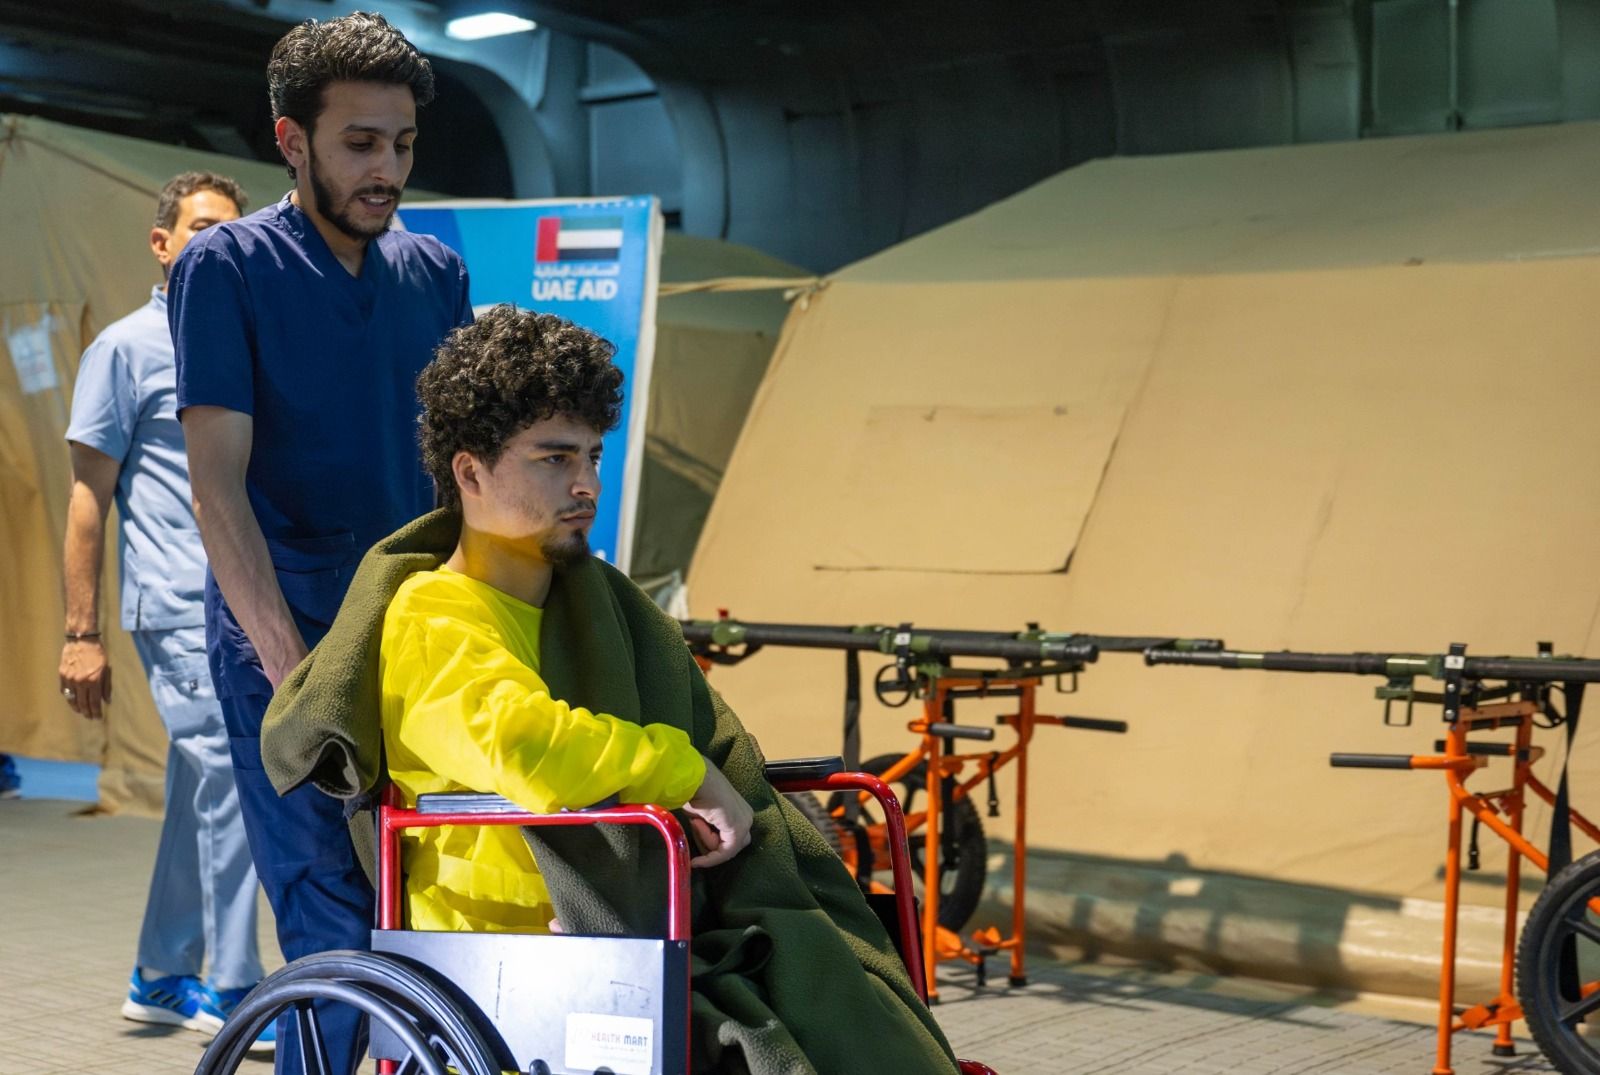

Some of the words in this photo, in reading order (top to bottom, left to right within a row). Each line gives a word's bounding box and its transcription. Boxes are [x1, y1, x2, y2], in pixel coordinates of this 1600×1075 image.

[532, 279, 577, 301] UAE
[578, 278, 618, 300] AID
[623, 1034, 648, 1047] MART
